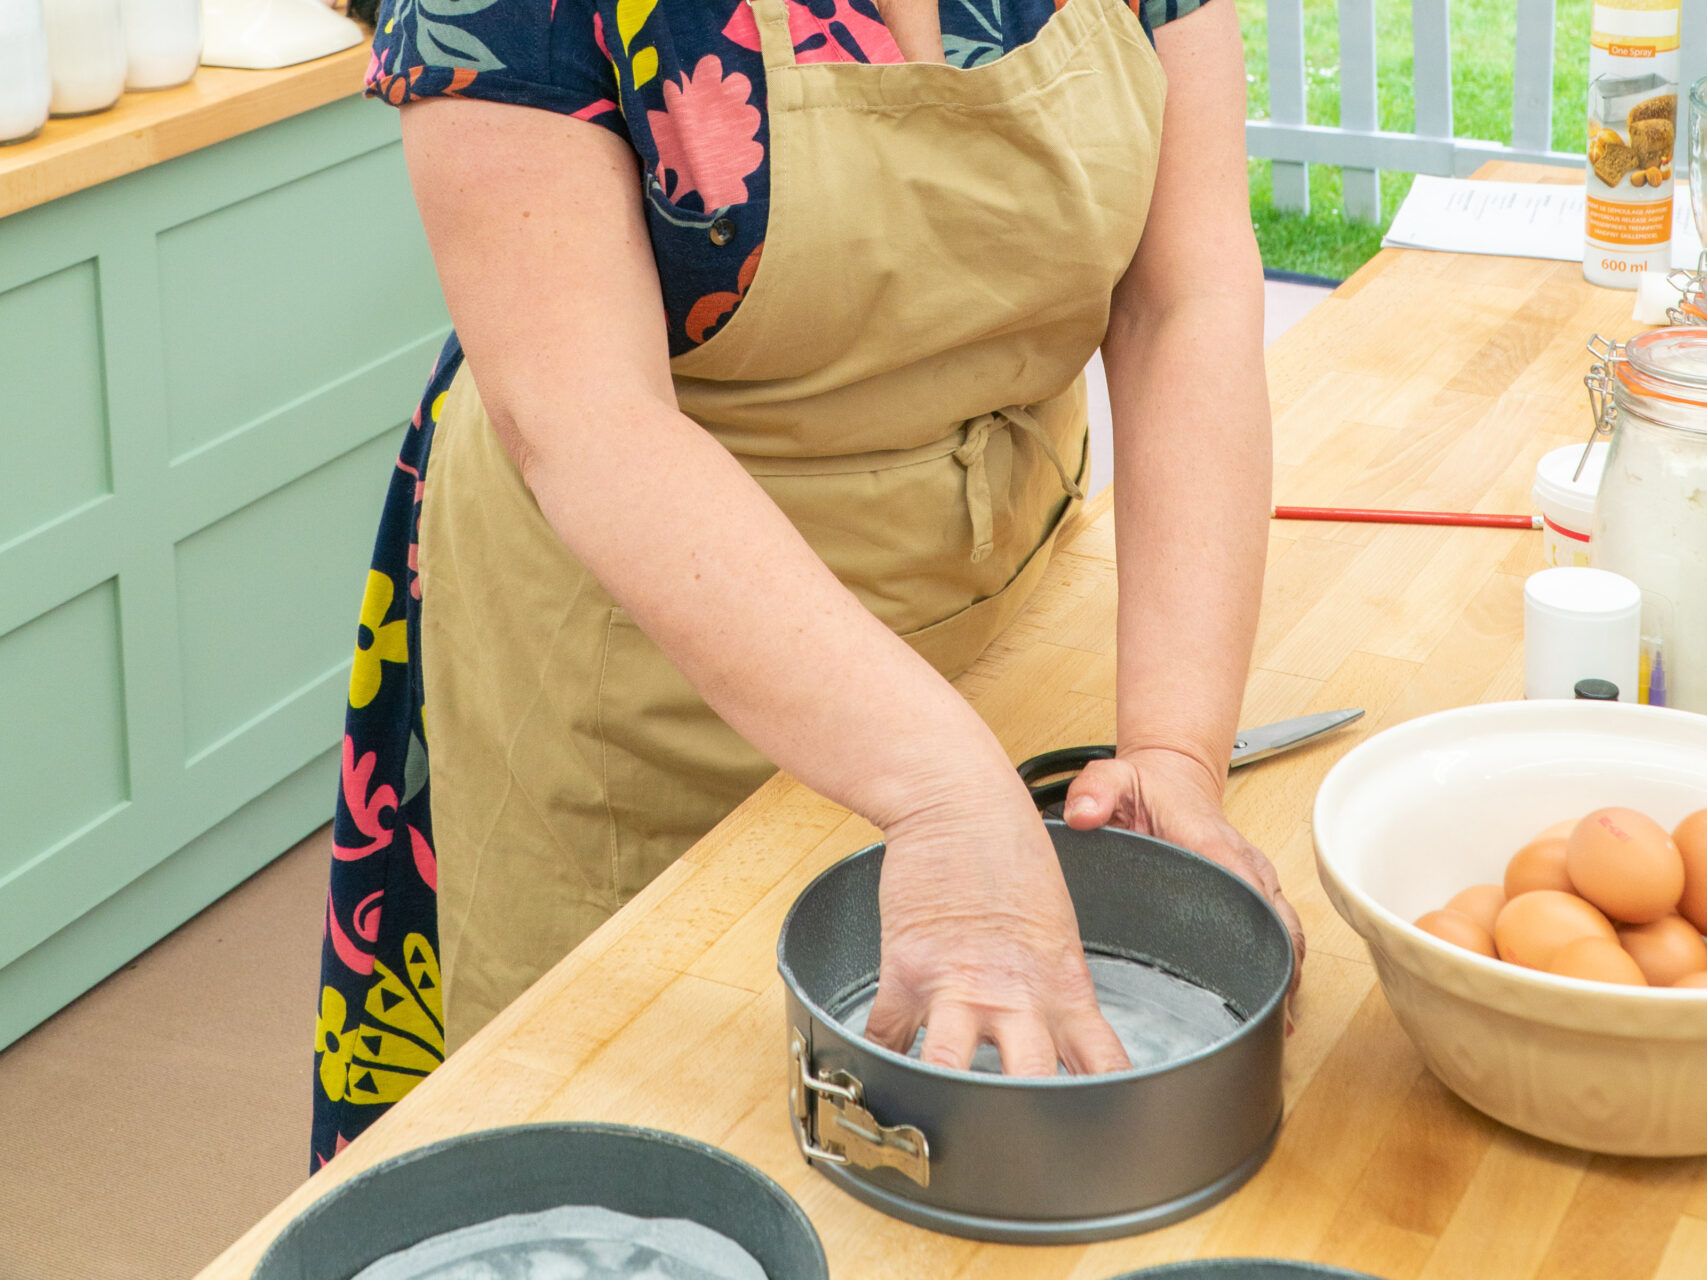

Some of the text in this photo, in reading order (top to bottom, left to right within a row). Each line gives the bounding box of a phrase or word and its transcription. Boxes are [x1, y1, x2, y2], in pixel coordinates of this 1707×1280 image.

[1611, 47, 1652, 57] One Spray
[1601, 258, 1648, 273] 600 ml
